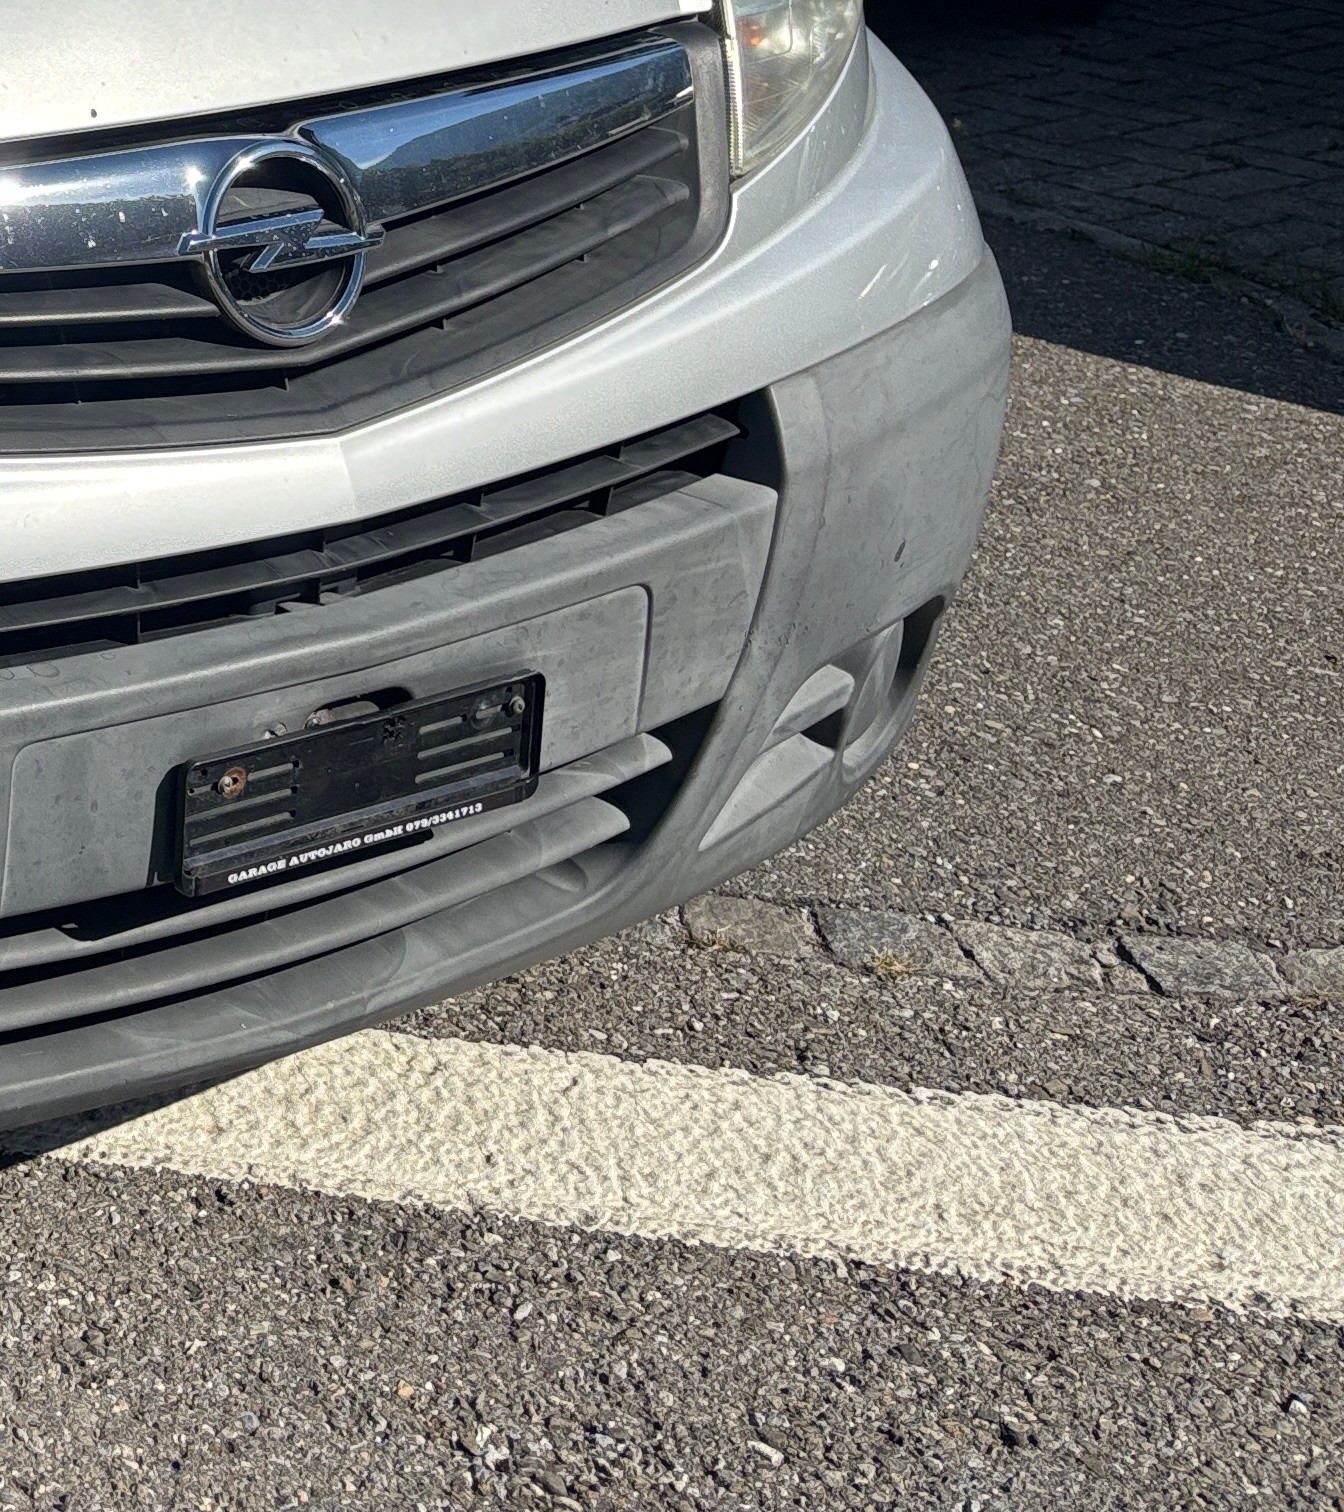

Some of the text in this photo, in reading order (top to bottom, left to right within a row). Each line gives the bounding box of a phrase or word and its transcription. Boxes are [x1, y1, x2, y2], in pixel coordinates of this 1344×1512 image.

[227, 858, 286, 884] GARAGE
[288, 837, 362, 867] AUTOJARO
[363, 825, 404, 844] GmbH
